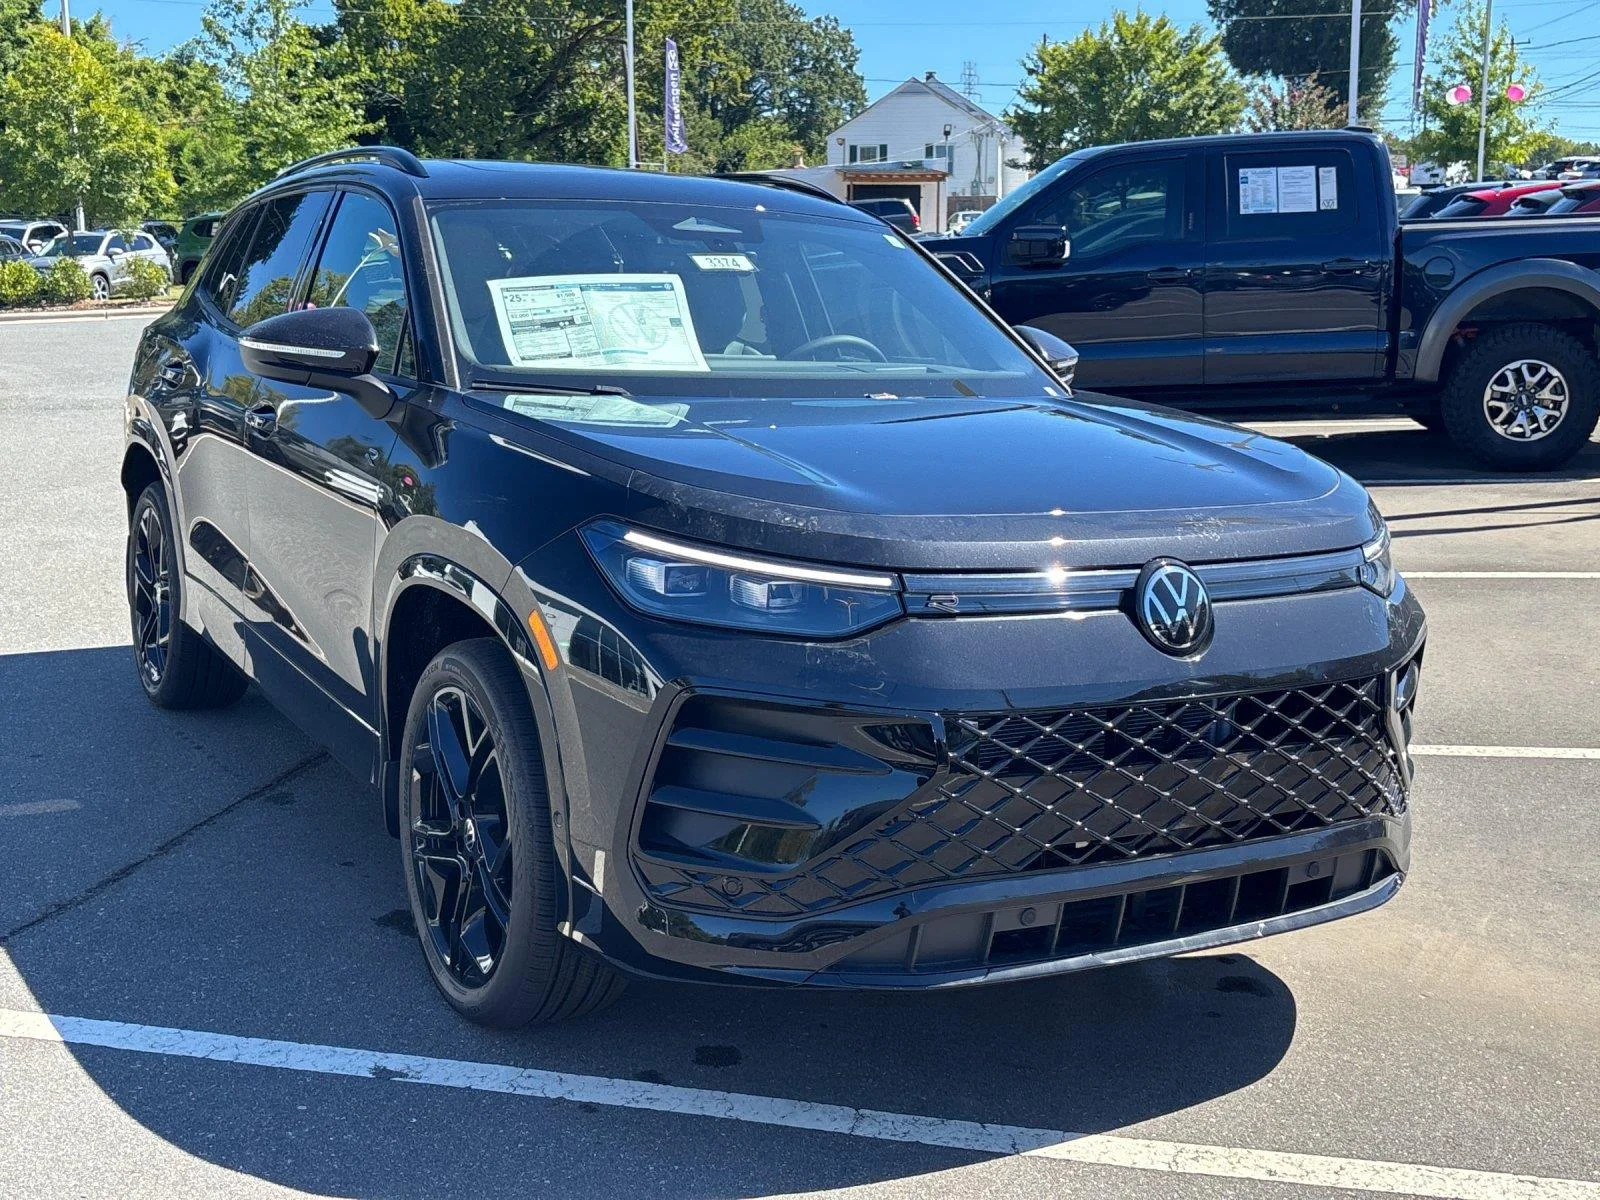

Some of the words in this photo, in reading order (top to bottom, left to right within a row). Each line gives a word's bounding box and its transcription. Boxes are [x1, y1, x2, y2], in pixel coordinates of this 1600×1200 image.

[705, 257, 741, 268] 3374
[509, 294, 522, 303] 25
[927, 594, 960, 614] R
